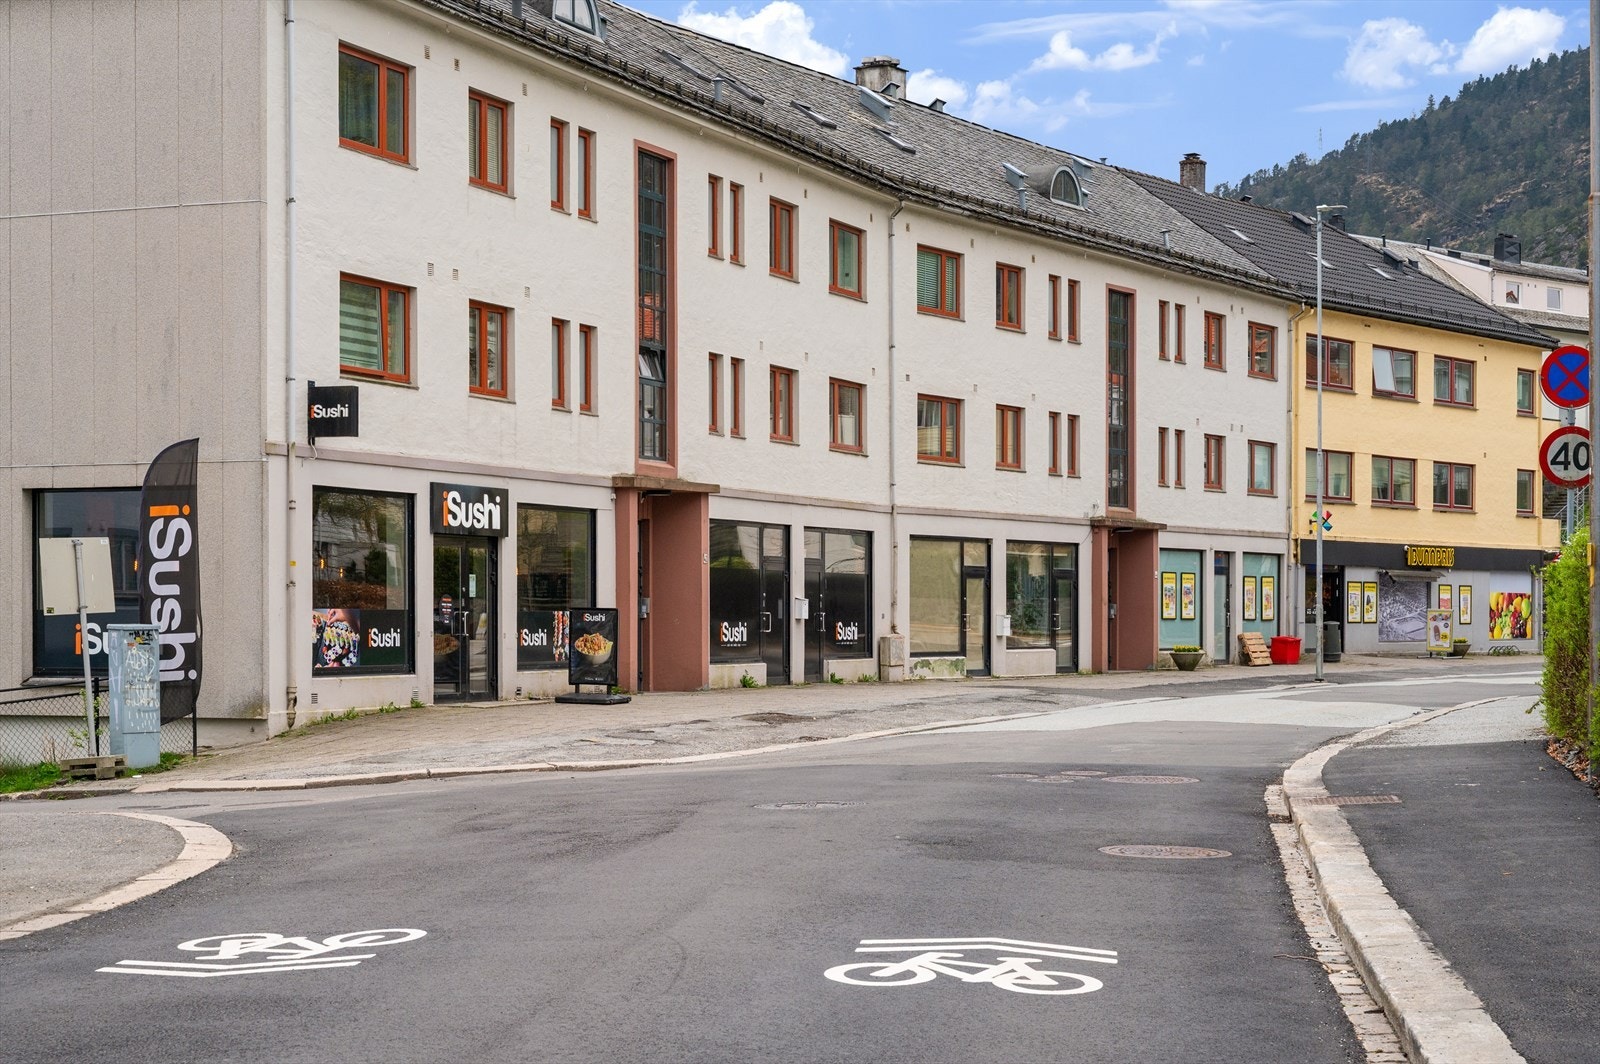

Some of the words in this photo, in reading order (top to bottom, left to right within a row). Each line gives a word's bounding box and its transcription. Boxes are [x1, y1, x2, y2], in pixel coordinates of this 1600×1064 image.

[310, 403, 349, 419] iSushi
[1550, 441, 1590, 471] 40
[443, 490, 501, 530] iSushi
[148, 504, 198, 682] iSushi
[583, 613, 606, 622] iSushi
[368, 627, 401, 648] iSushi
[520, 628, 547, 647] iSushi
[720, 621, 748, 642] iSushi
[835, 621, 858, 641] iSushi
